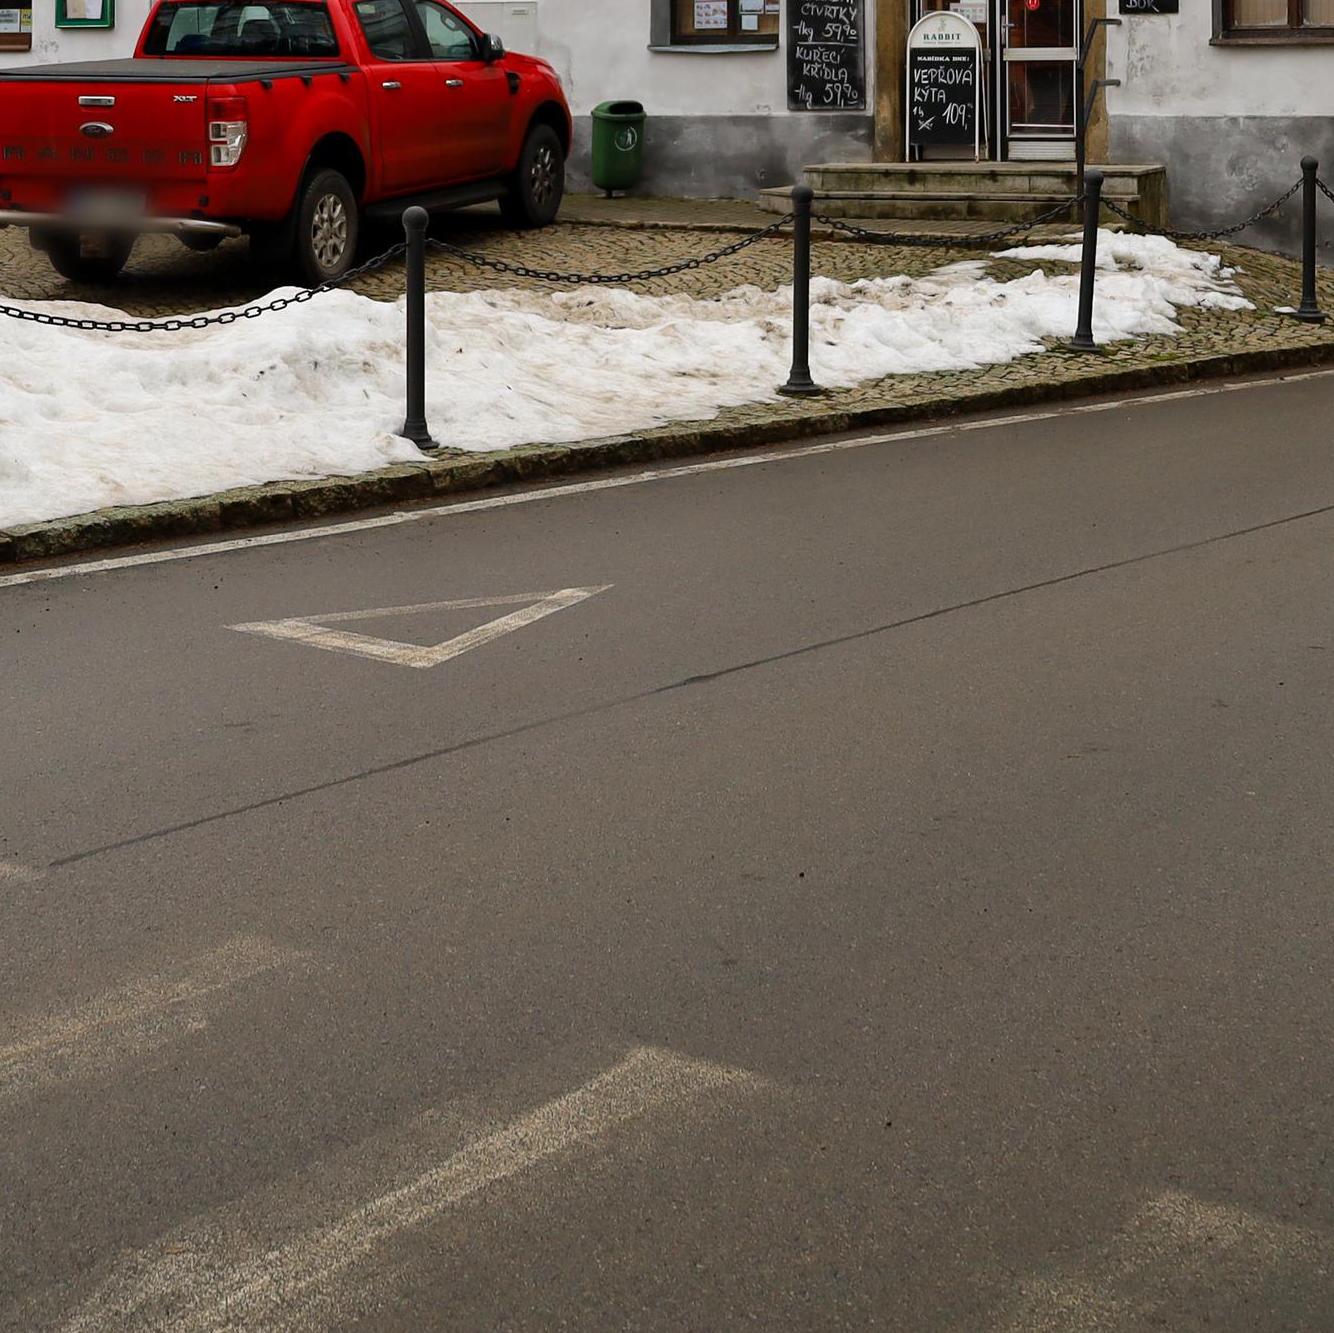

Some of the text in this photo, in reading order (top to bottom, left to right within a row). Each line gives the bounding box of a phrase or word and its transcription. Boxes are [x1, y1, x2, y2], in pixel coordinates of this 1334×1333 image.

[923, 33, 962, 41] RABBIT
[796, 46, 845, 64] KUŘECÍ
[803, 62, 847, 83] KŘÍDLA
[914, 63, 973, 86] VEPŘOVÁ
[914, 85, 946, 104] KÝTA
